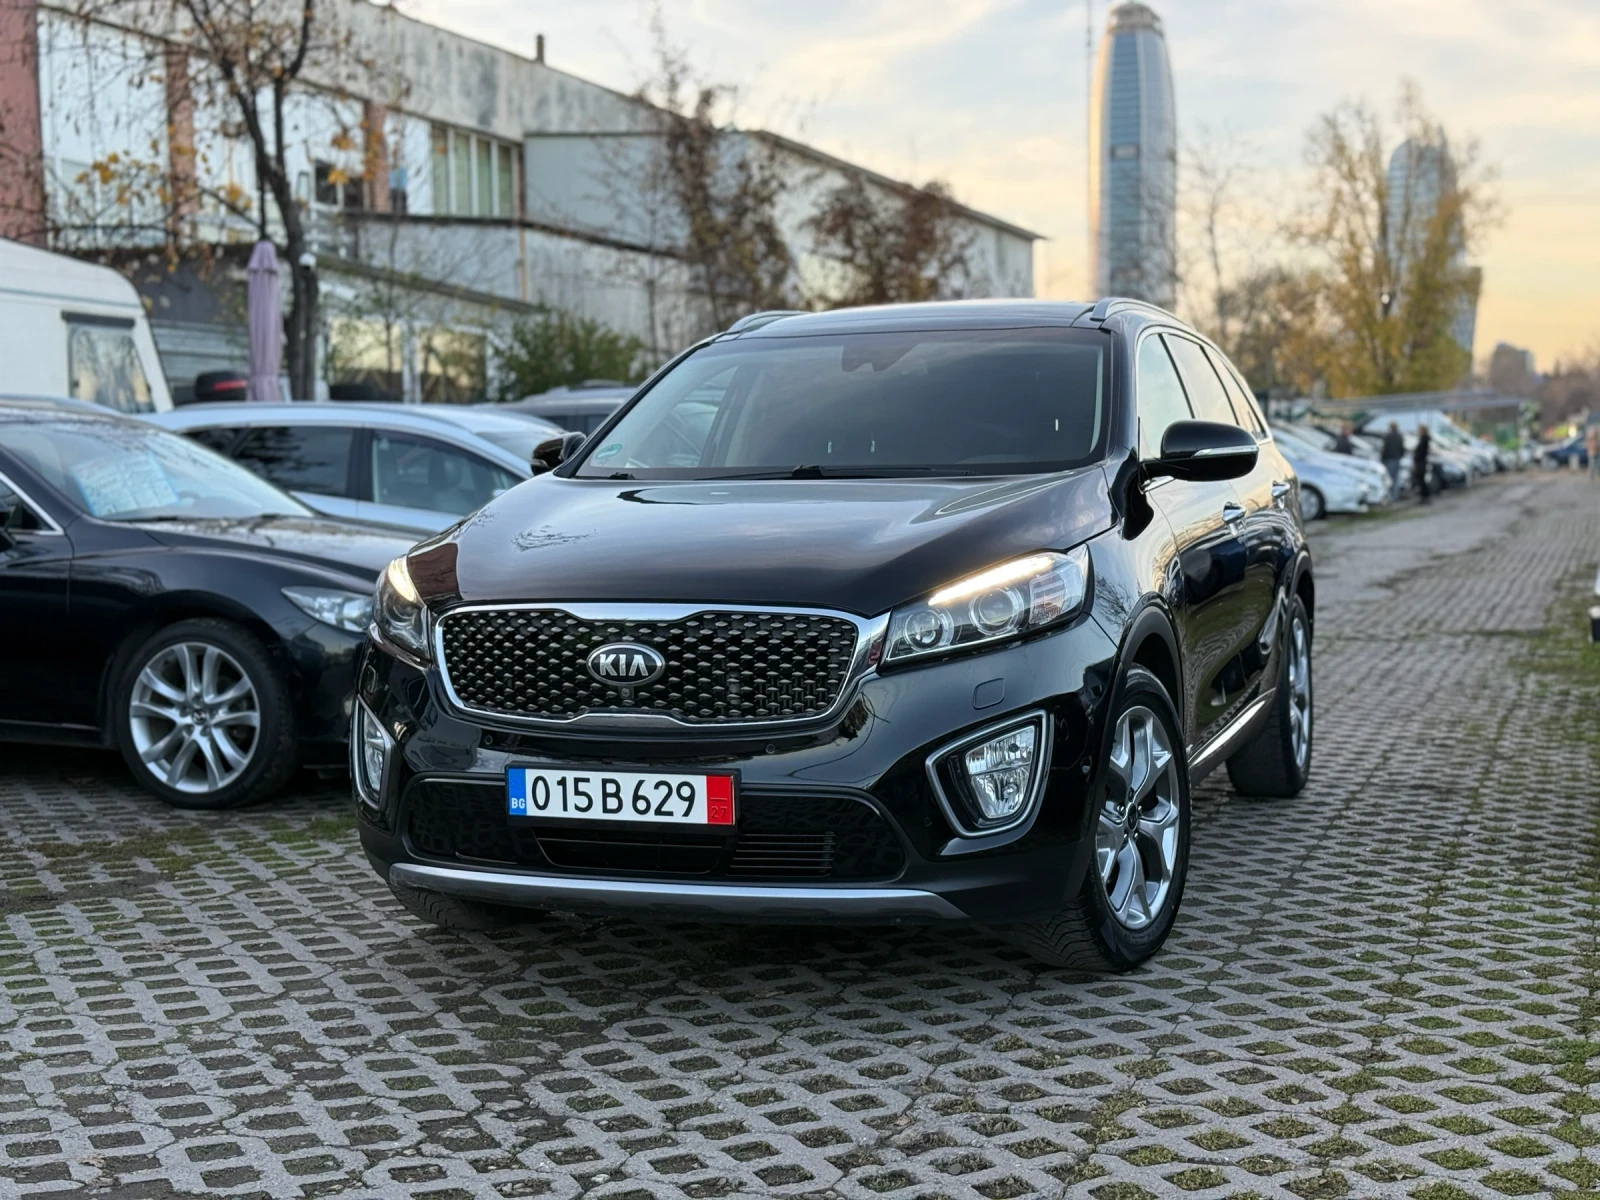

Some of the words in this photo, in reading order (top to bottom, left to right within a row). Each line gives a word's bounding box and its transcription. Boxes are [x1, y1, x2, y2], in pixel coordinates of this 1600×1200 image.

[599, 653, 649, 677] KIA
[511, 797, 526, 809] BG
[710, 805, 728, 819] 27
